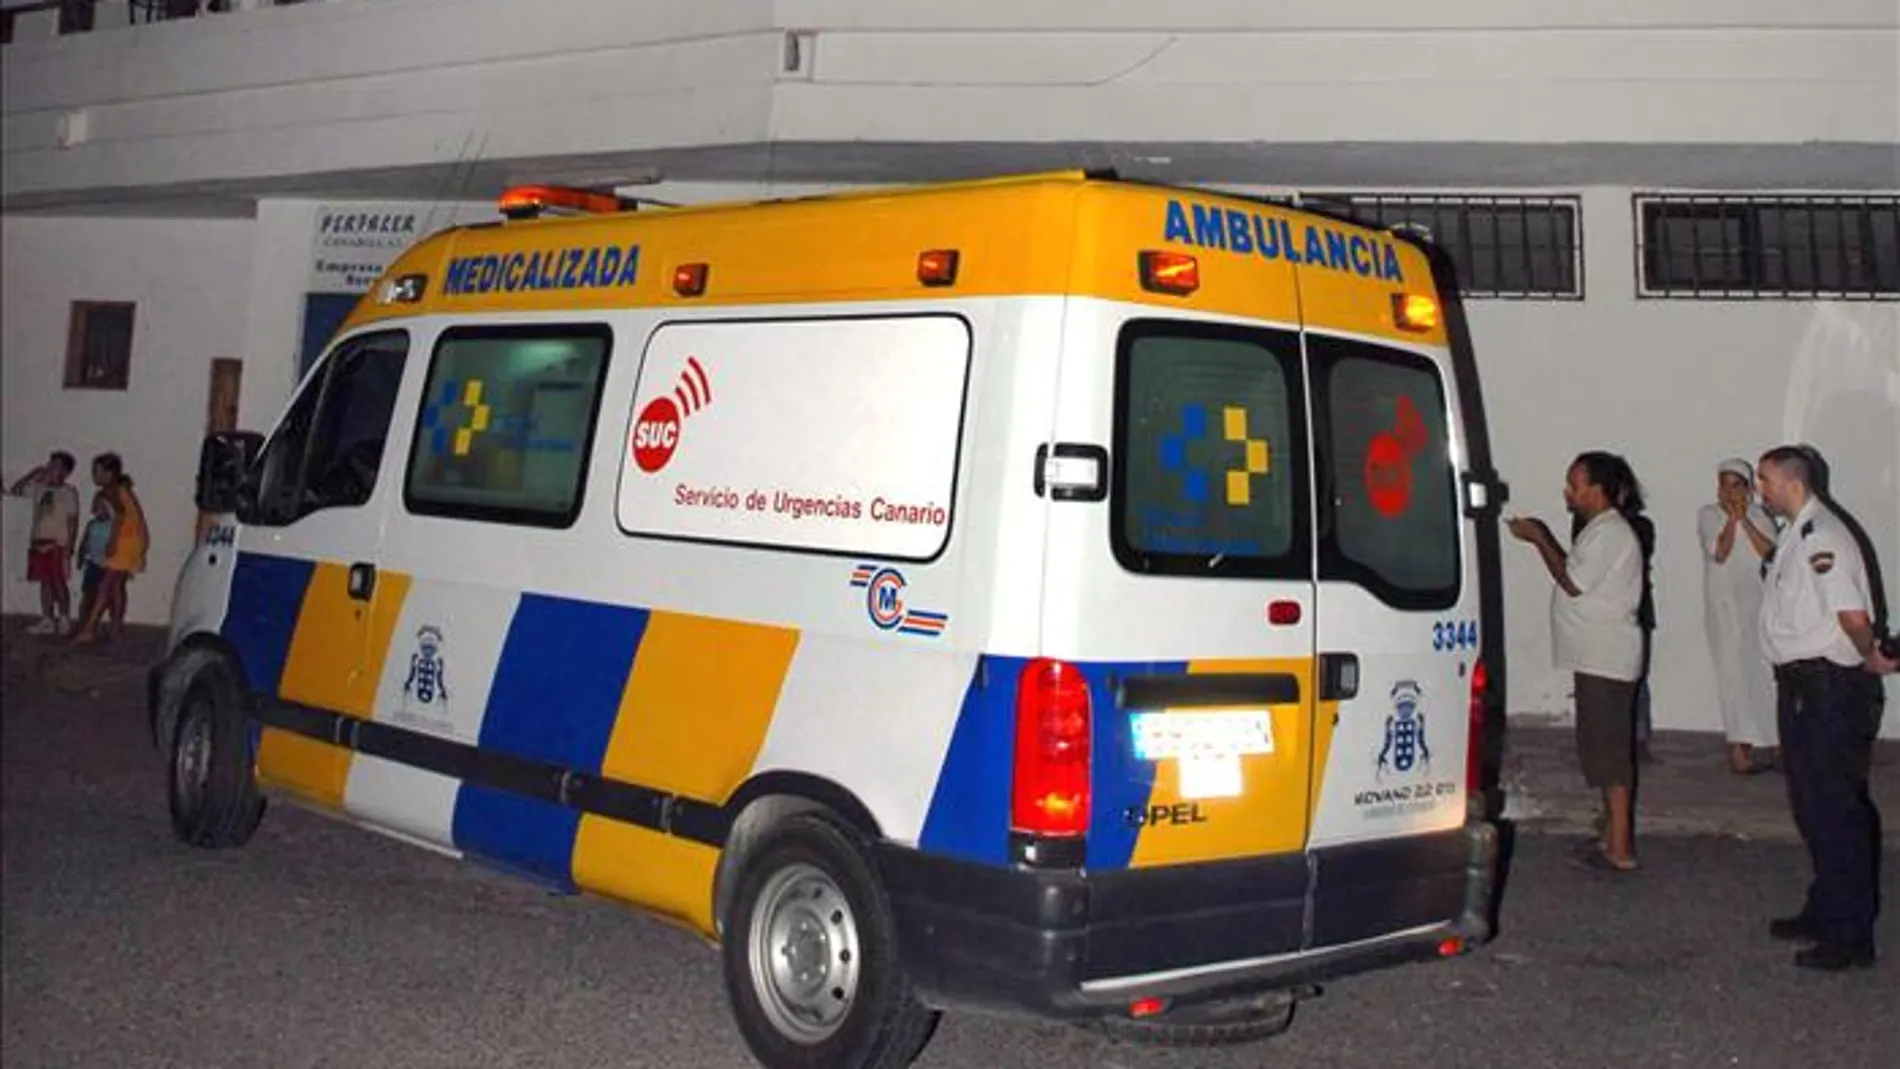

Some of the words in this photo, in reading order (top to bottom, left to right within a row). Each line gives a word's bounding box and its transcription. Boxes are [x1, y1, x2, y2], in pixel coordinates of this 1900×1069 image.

[1165, 201, 1403, 282] AMBULANCIA
[443, 244, 640, 295] MEDICALIZADA
[635, 421, 677, 448] SUC
[675, 484, 740, 509] Servicio
[745, 489, 767, 512] de
[773, 489, 863, 521] Urgencias
[869, 496, 947, 527] Canario
[1432, 620, 1477, 651] 3344
[1125, 802, 1208, 827] OPEL
